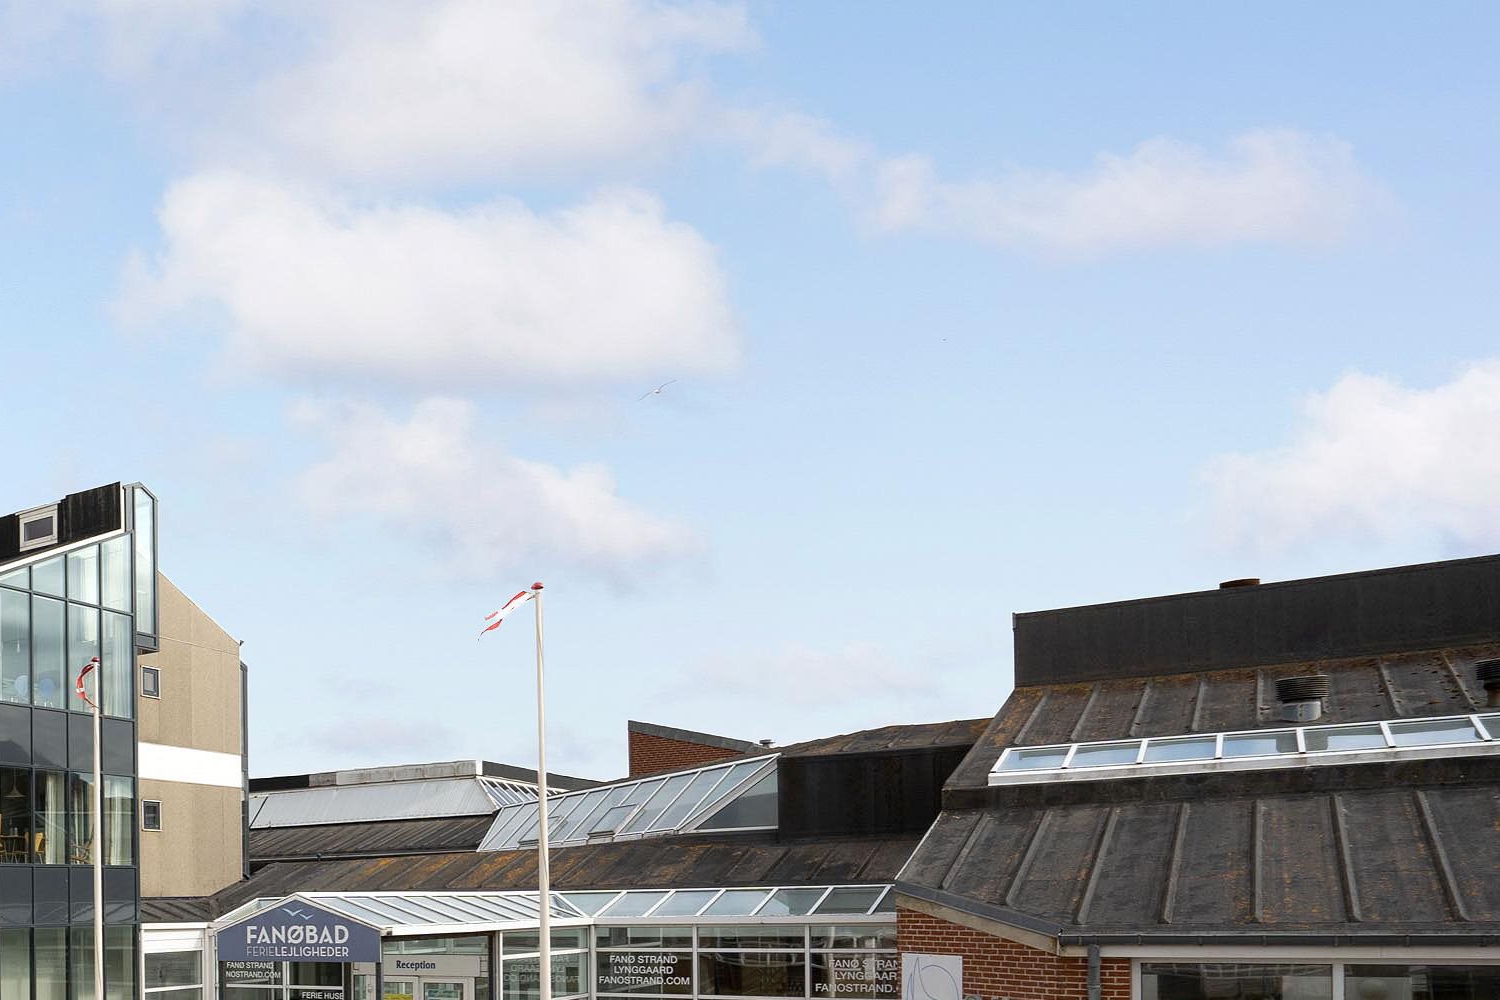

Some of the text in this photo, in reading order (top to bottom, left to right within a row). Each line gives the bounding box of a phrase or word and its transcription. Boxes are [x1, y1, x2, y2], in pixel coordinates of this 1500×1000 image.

[246, 925, 349, 944] FANØBAD
[246, 946, 349, 957] FERIELEJLIGHEDER
[609, 955, 678, 964] FANØ STRAND
[828, 959, 859, 968] FANØ
[245, 961, 274, 969] STRAND
[396, 960, 436, 971] Reception
[613, 966, 674, 974] LYNGGAARD
[598, 976, 690, 985] FANOSTRAND.COM
[815, 983, 898, 993] FANOSTRAND.
[302, 991, 323, 1000] FERIE
